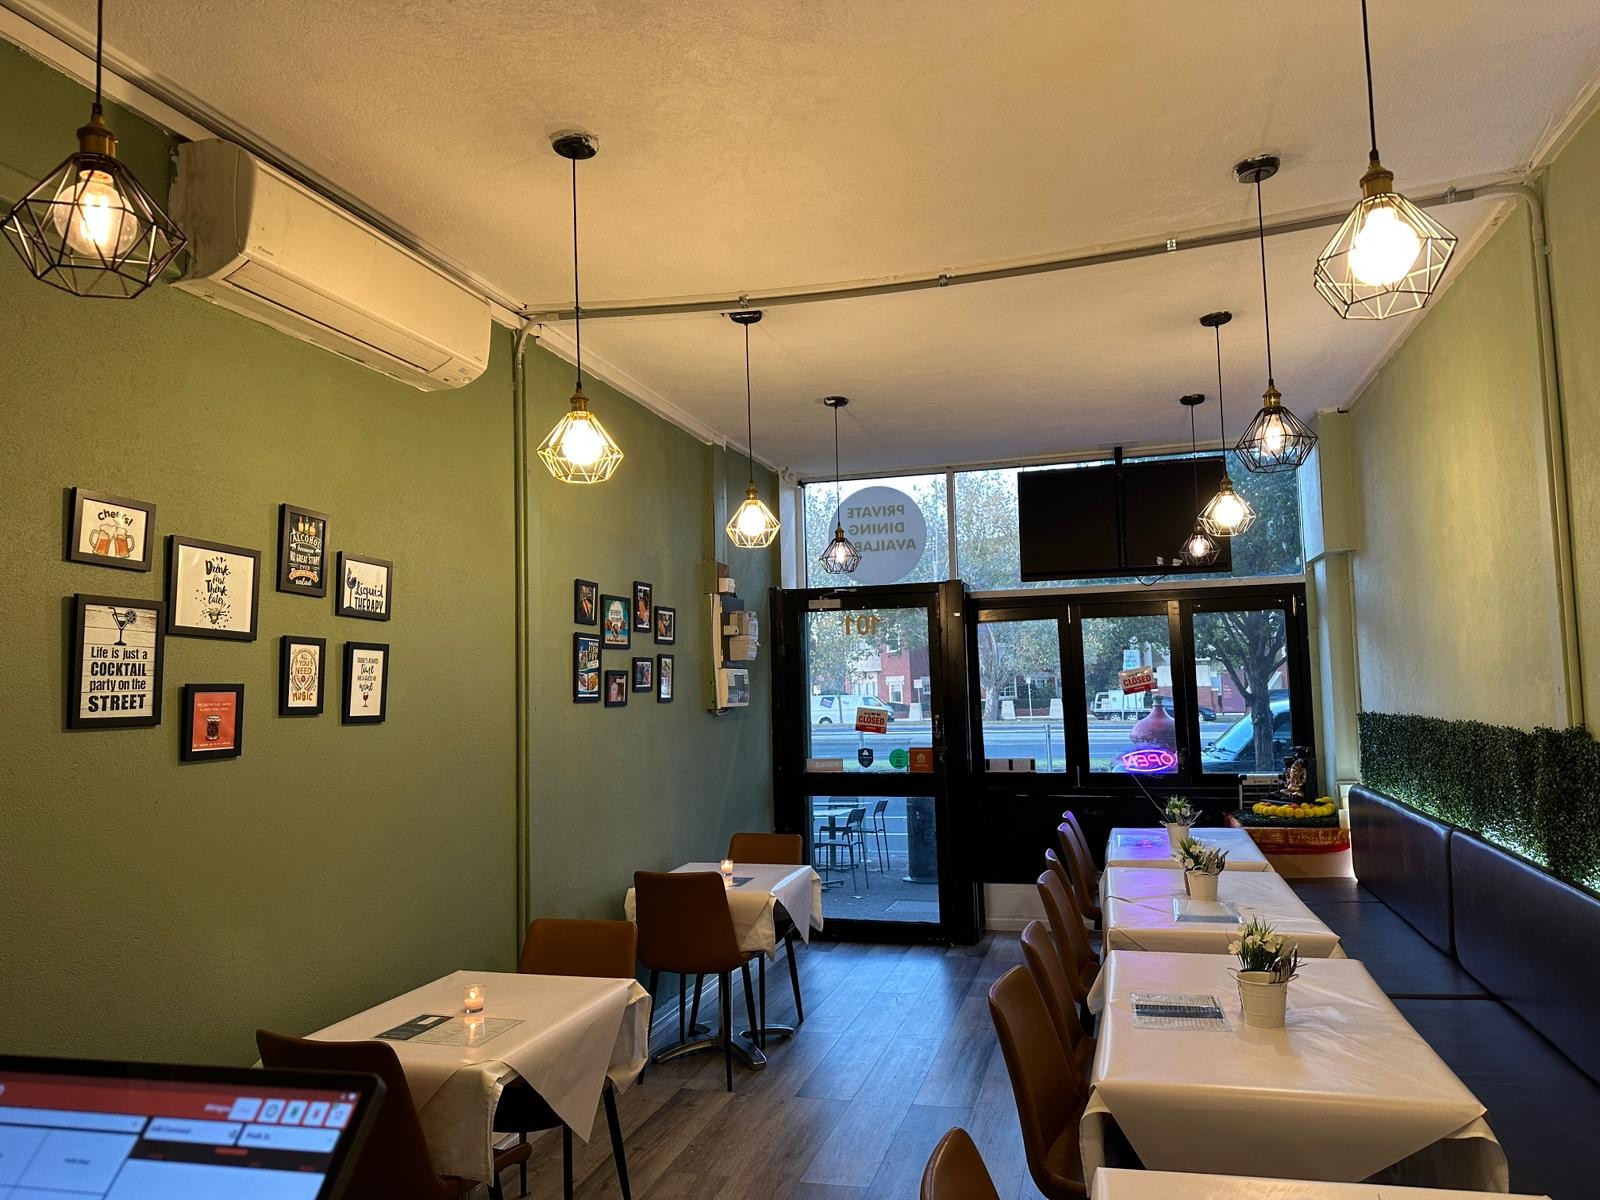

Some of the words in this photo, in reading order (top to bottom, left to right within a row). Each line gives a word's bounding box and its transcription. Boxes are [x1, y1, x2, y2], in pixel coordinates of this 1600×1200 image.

[292, 533, 321, 548] ALCOHOL
[205, 560, 229, 576] Drink
[205, 580, 228, 596] Think
[354, 597, 384, 613] THERAPY
[91, 646, 108, 659] Life
[111, 647, 120, 659] is
[122, 647, 139, 661] just
[142, 649, 148, 660] a
[90, 662, 147, 677] COCKTAIL
[295, 667, 313, 675] NEED
[89, 679, 116, 693] party
[118, 681, 130, 690] on
[131, 678, 147, 690] the
[1123, 675, 1152, 686] CLOSED
[88, 694, 147, 713] STREET
[292, 691, 313, 702] MUSIC
[858, 715, 885, 726] CLOSED
